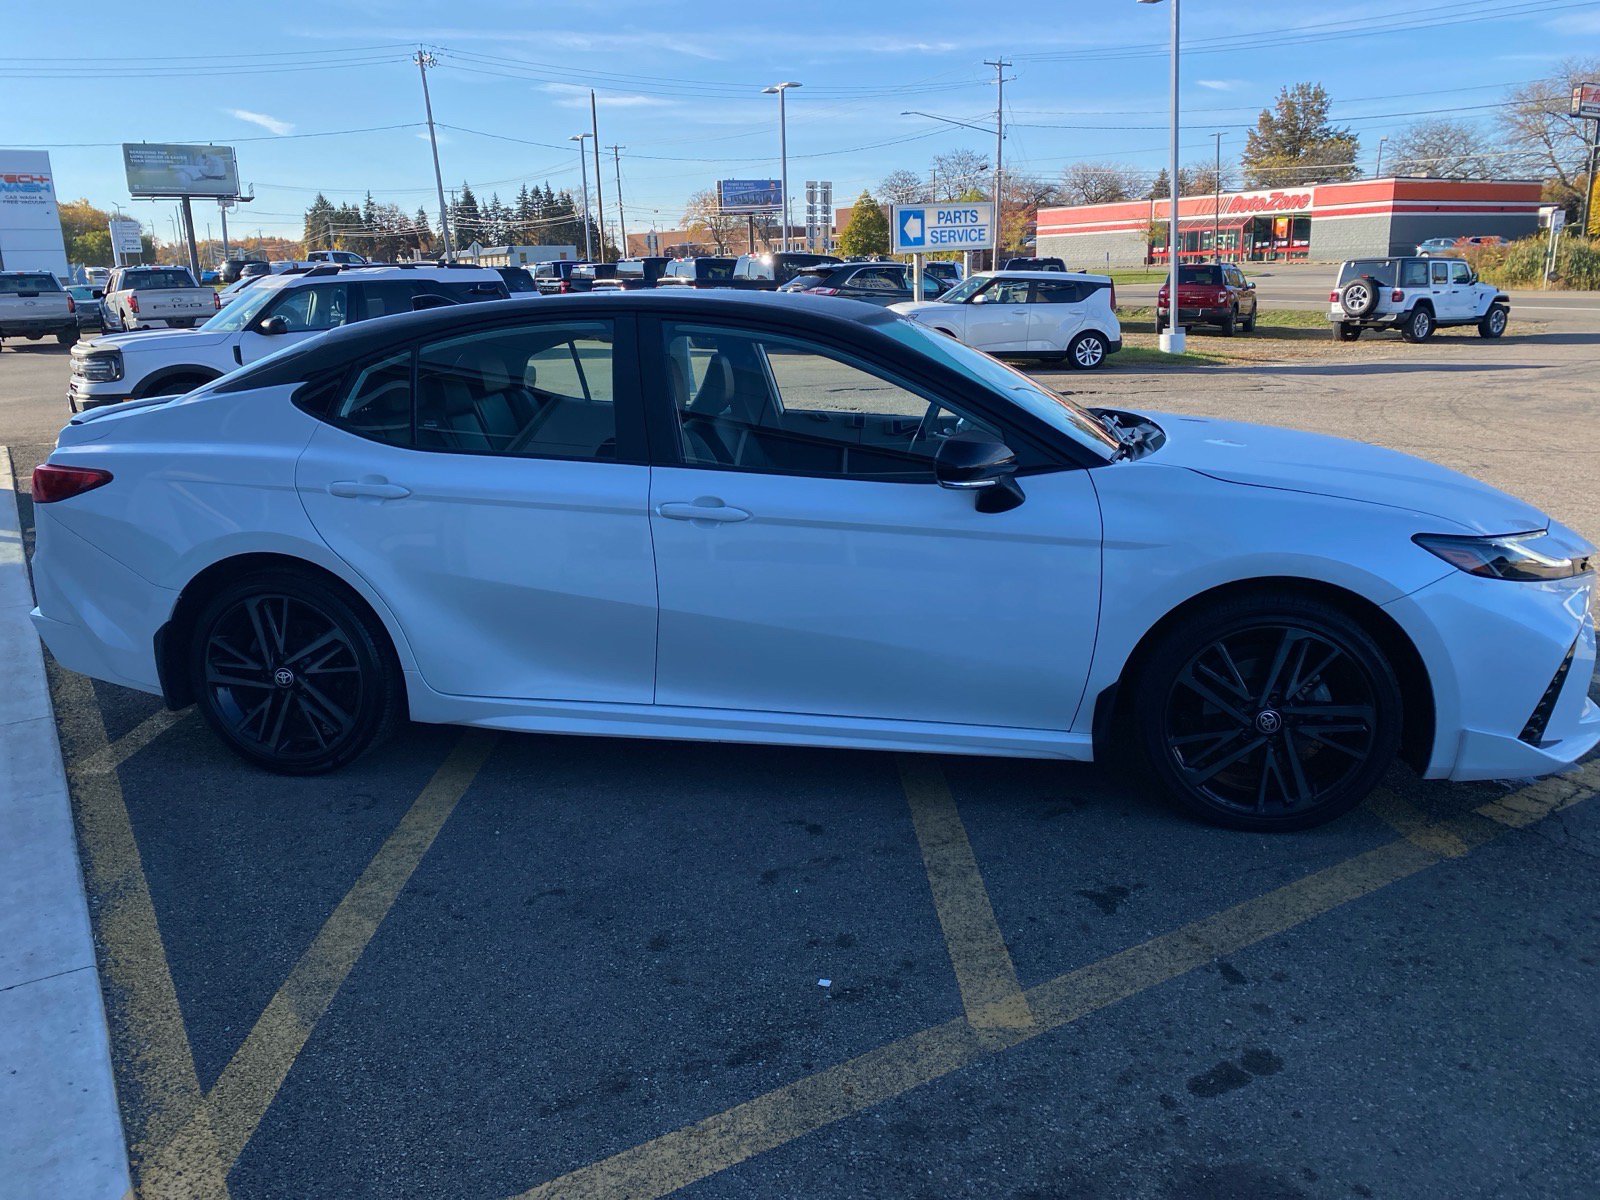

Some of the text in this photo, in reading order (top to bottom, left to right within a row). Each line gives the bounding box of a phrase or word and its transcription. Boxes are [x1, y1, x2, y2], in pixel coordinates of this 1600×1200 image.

[0, 174, 50, 183] ECH
[1227, 192, 1312, 214] AutoZone
[937, 209, 979, 225] PARTS
[930, 228, 986, 244] SERVICE
